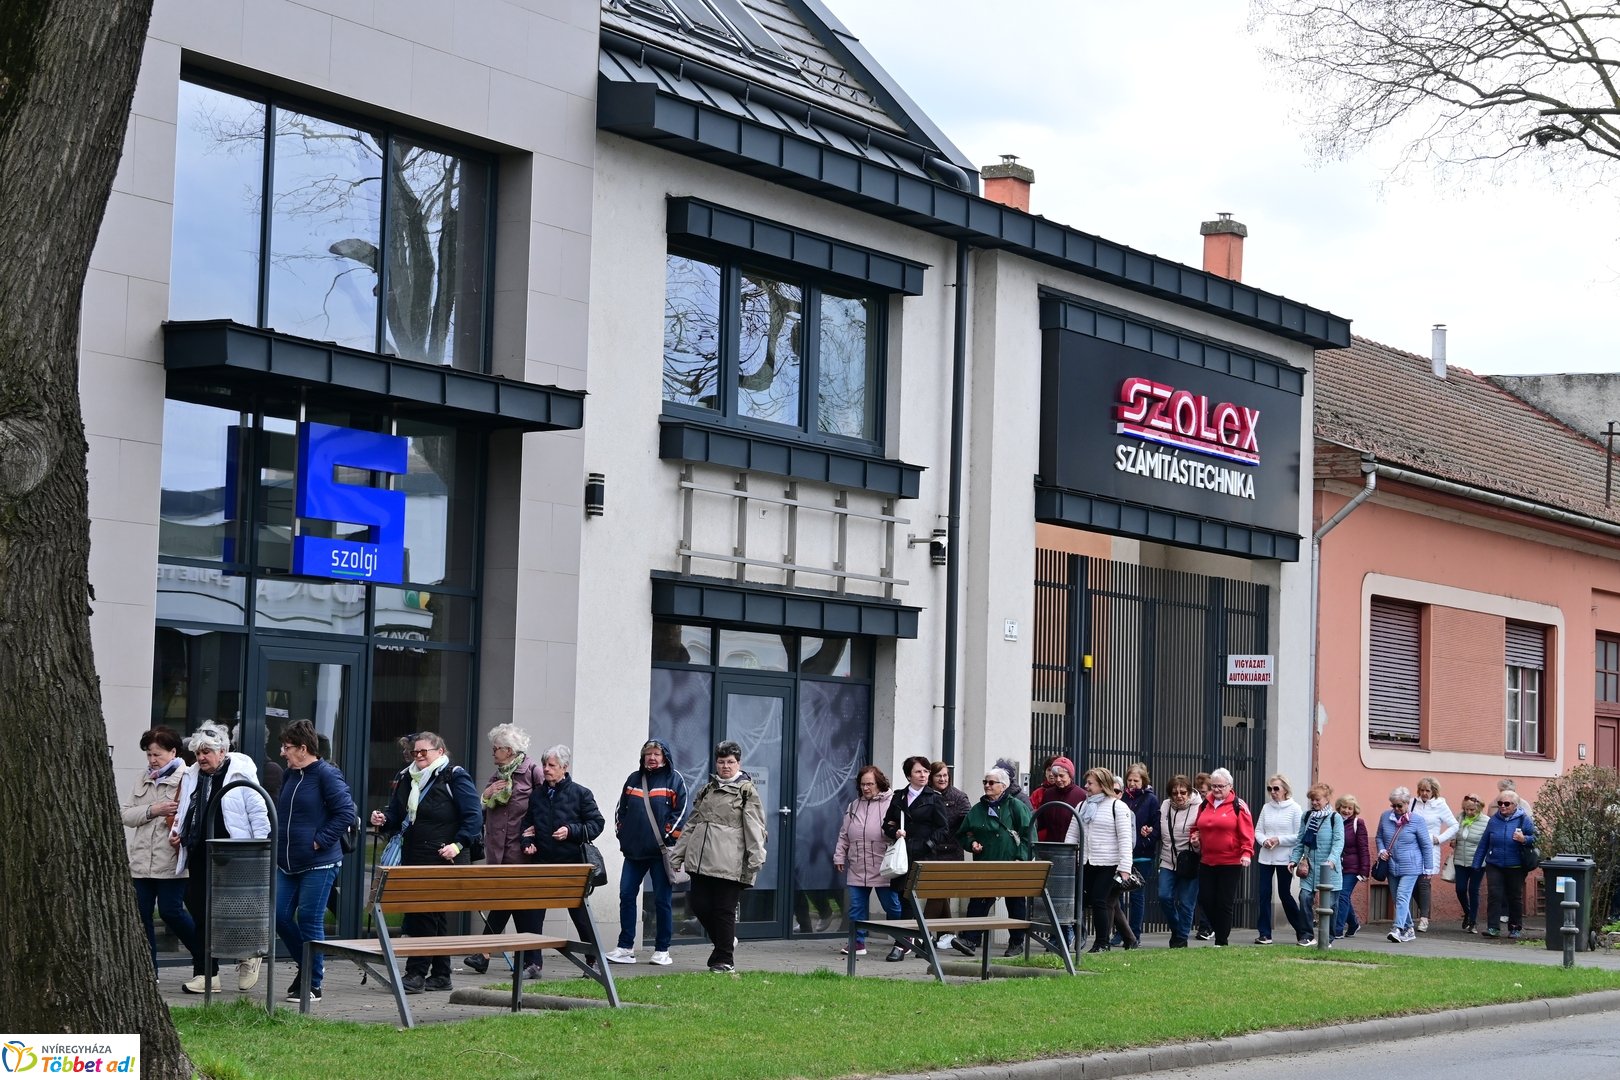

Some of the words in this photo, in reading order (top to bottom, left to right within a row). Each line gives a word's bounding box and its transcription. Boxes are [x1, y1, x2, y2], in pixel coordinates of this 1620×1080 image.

[1115, 442, 1255, 499] SZÁMÍTÁSTECHNIKA
[331, 546, 378, 577] szolgi
[1234, 657, 1266, 669] VIGYÁZAT!
[1229, 671, 1271, 682] AUTÓKIJÁRAT!
